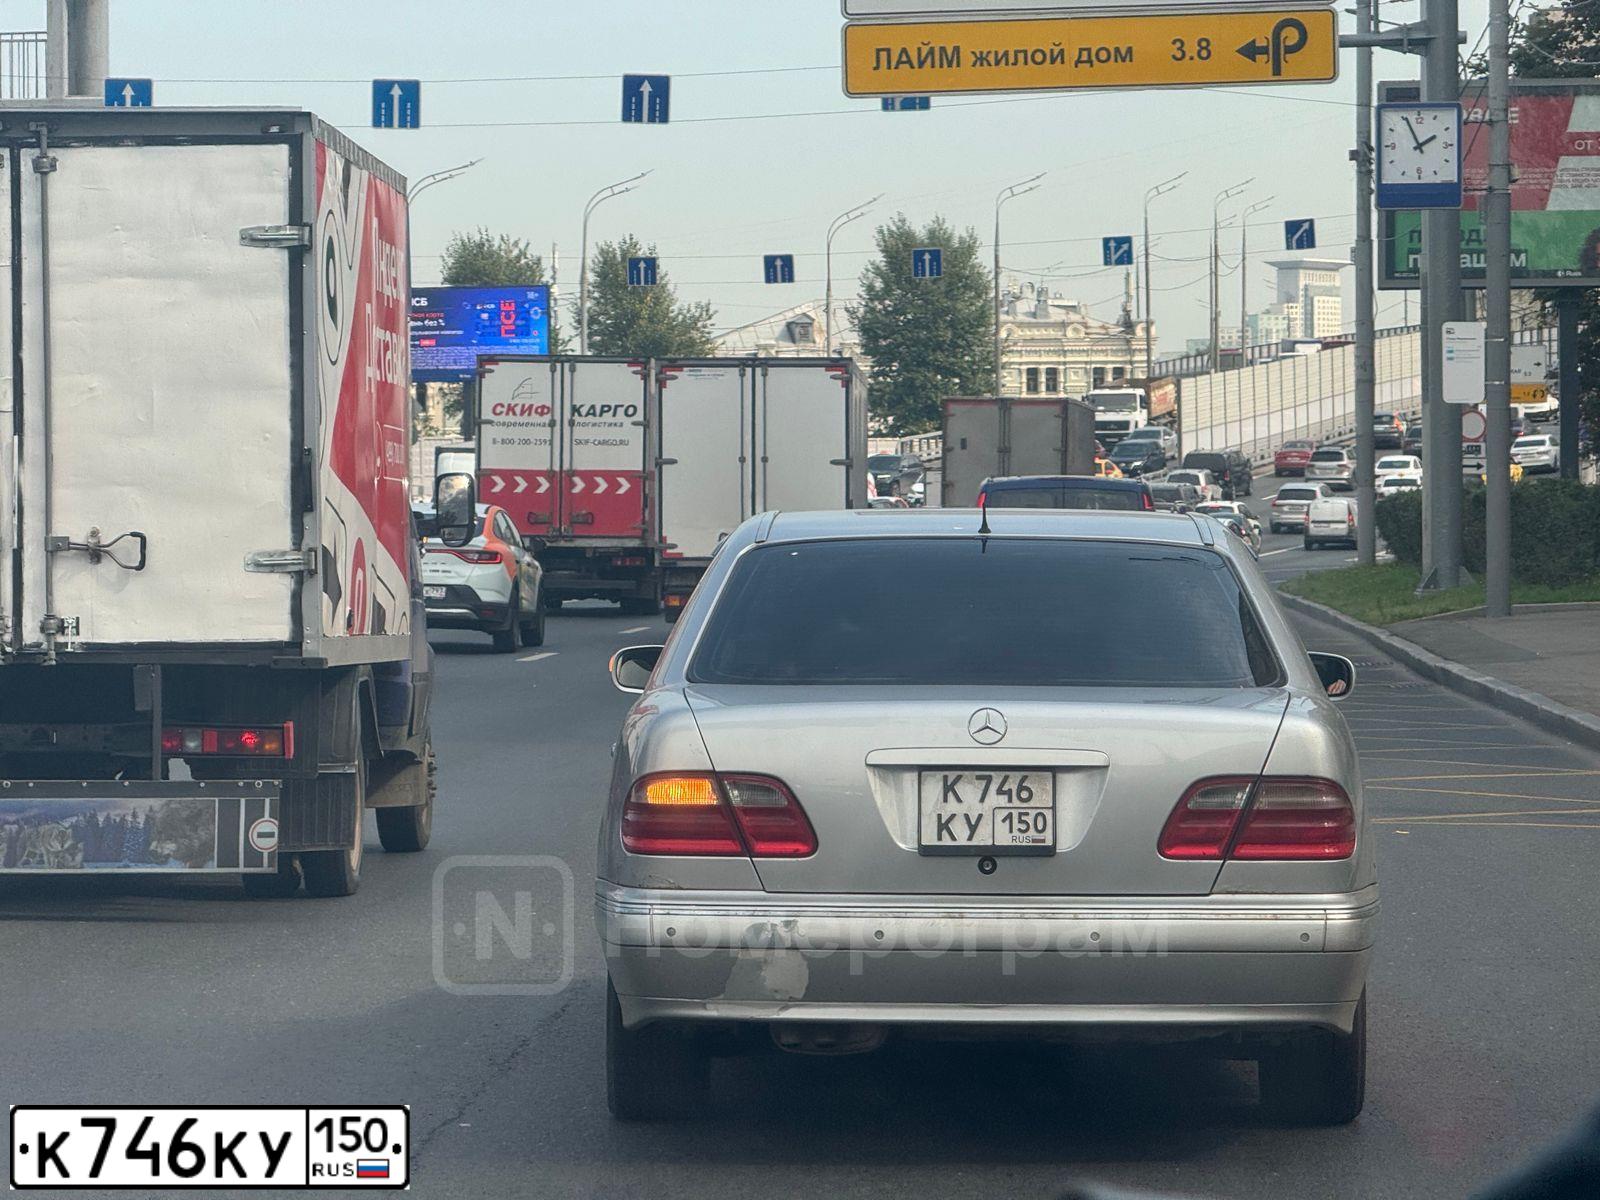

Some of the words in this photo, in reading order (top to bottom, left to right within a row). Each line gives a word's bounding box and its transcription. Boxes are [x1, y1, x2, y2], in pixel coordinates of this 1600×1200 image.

[872, 40, 961, 71] ЛАЙМ
[970, 42, 1065, 68] жилой
[1074, 45, 1133, 68] дом
[1170, 37, 1212, 62] 3.8
[1414, 116, 1425, 125] 12
[1390, 142, 1397, 151] 9
[1442, 141, 1449, 150] 3
[1416, 166, 1423, 175] 6
[491, 402, 551, 417] СКИФ
[571, 404, 638, 418] КАРГО
[491, 420, 555, 429] современна
[942, 774, 963, 804] К
[975, 774, 1034, 804] 746
[1001, 811, 1047, 834] 150
[936, 813, 984, 842] КУ
[1011, 836, 1031, 844] RUS
